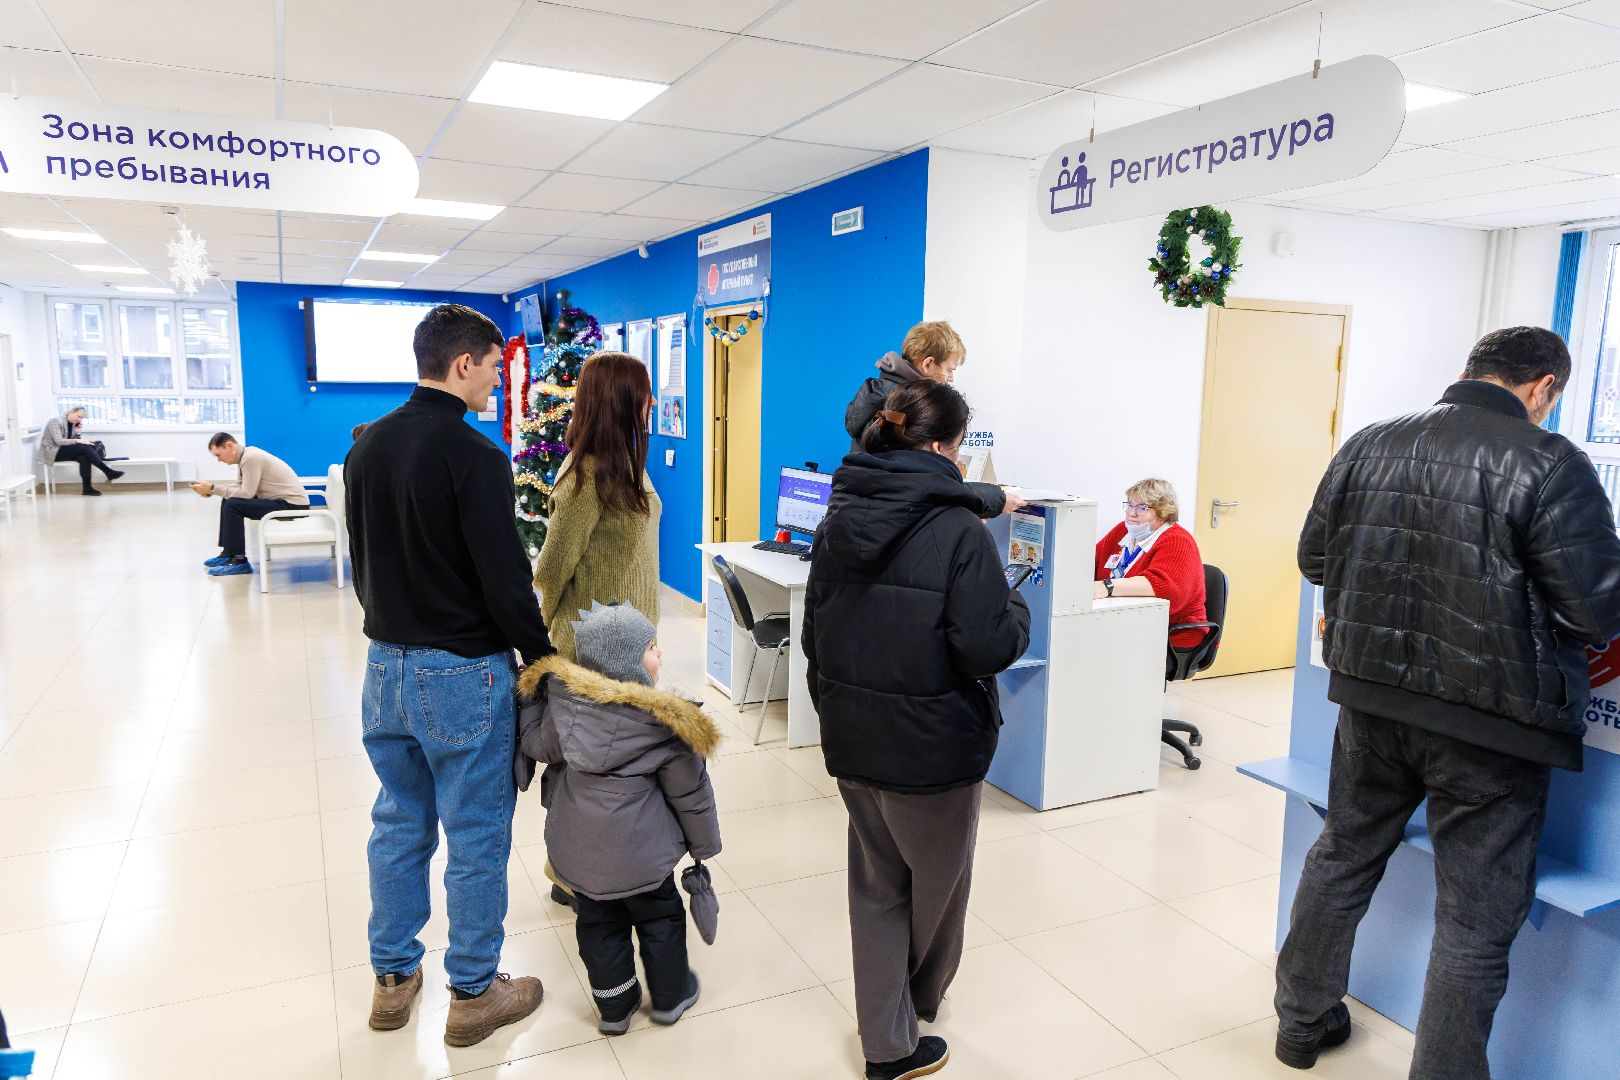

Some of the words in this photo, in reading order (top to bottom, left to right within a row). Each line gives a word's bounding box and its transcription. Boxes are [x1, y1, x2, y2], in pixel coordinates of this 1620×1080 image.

[42, 113, 135, 145] Зона
[147, 128, 381, 167] комфортного
[1109, 112, 1335, 189] Регистратура
[46, 154, 271, 190] пребывания
[961, 439, 994, 447] АБОТЫ
